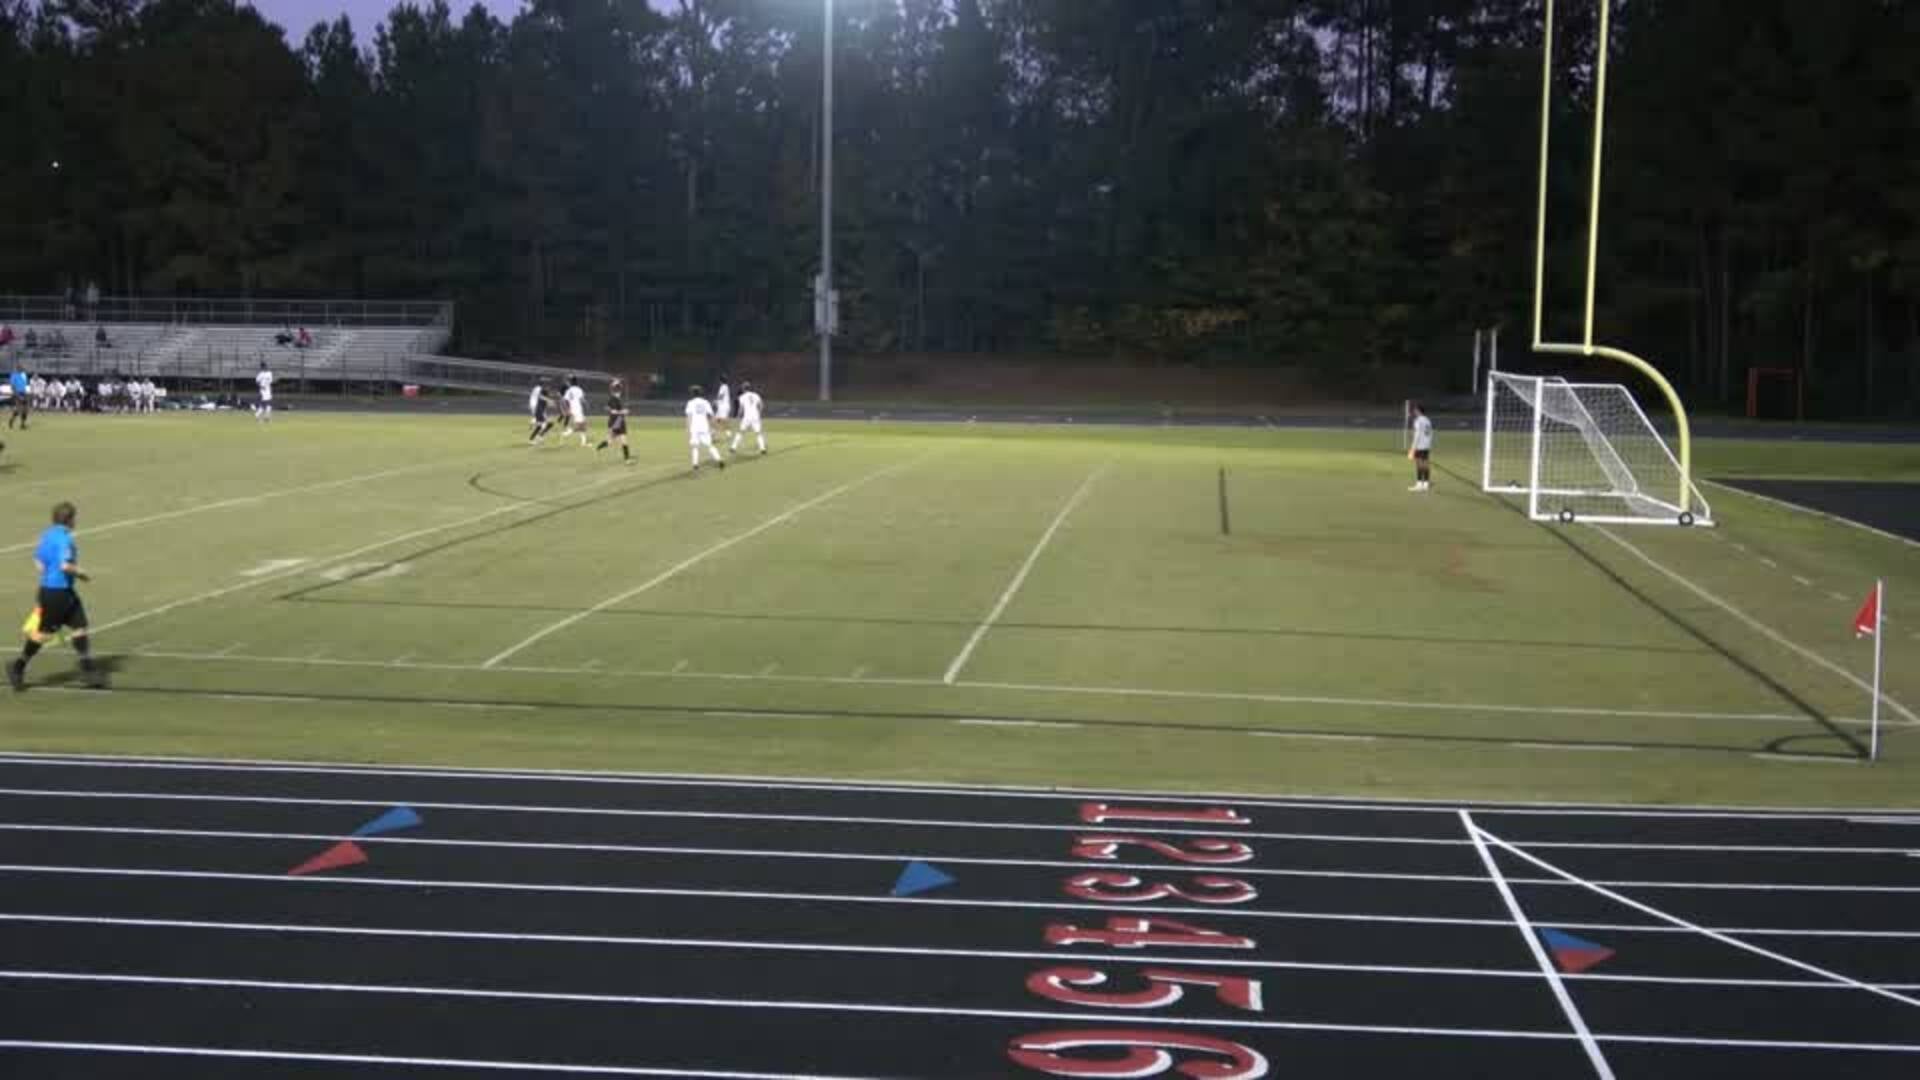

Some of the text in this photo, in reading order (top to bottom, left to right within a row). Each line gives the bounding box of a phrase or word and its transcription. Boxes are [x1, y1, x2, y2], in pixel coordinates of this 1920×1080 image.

[1080, 803, 1251, 823] 1
[1071, 835, 1254, 863] 2
[1062, 871, 1257, 903] 3
[1046, 917, 1256, 948] 4
[1026, 966, 1264, 1010] 5
[1007, 1029, 1269, 1080] 6
